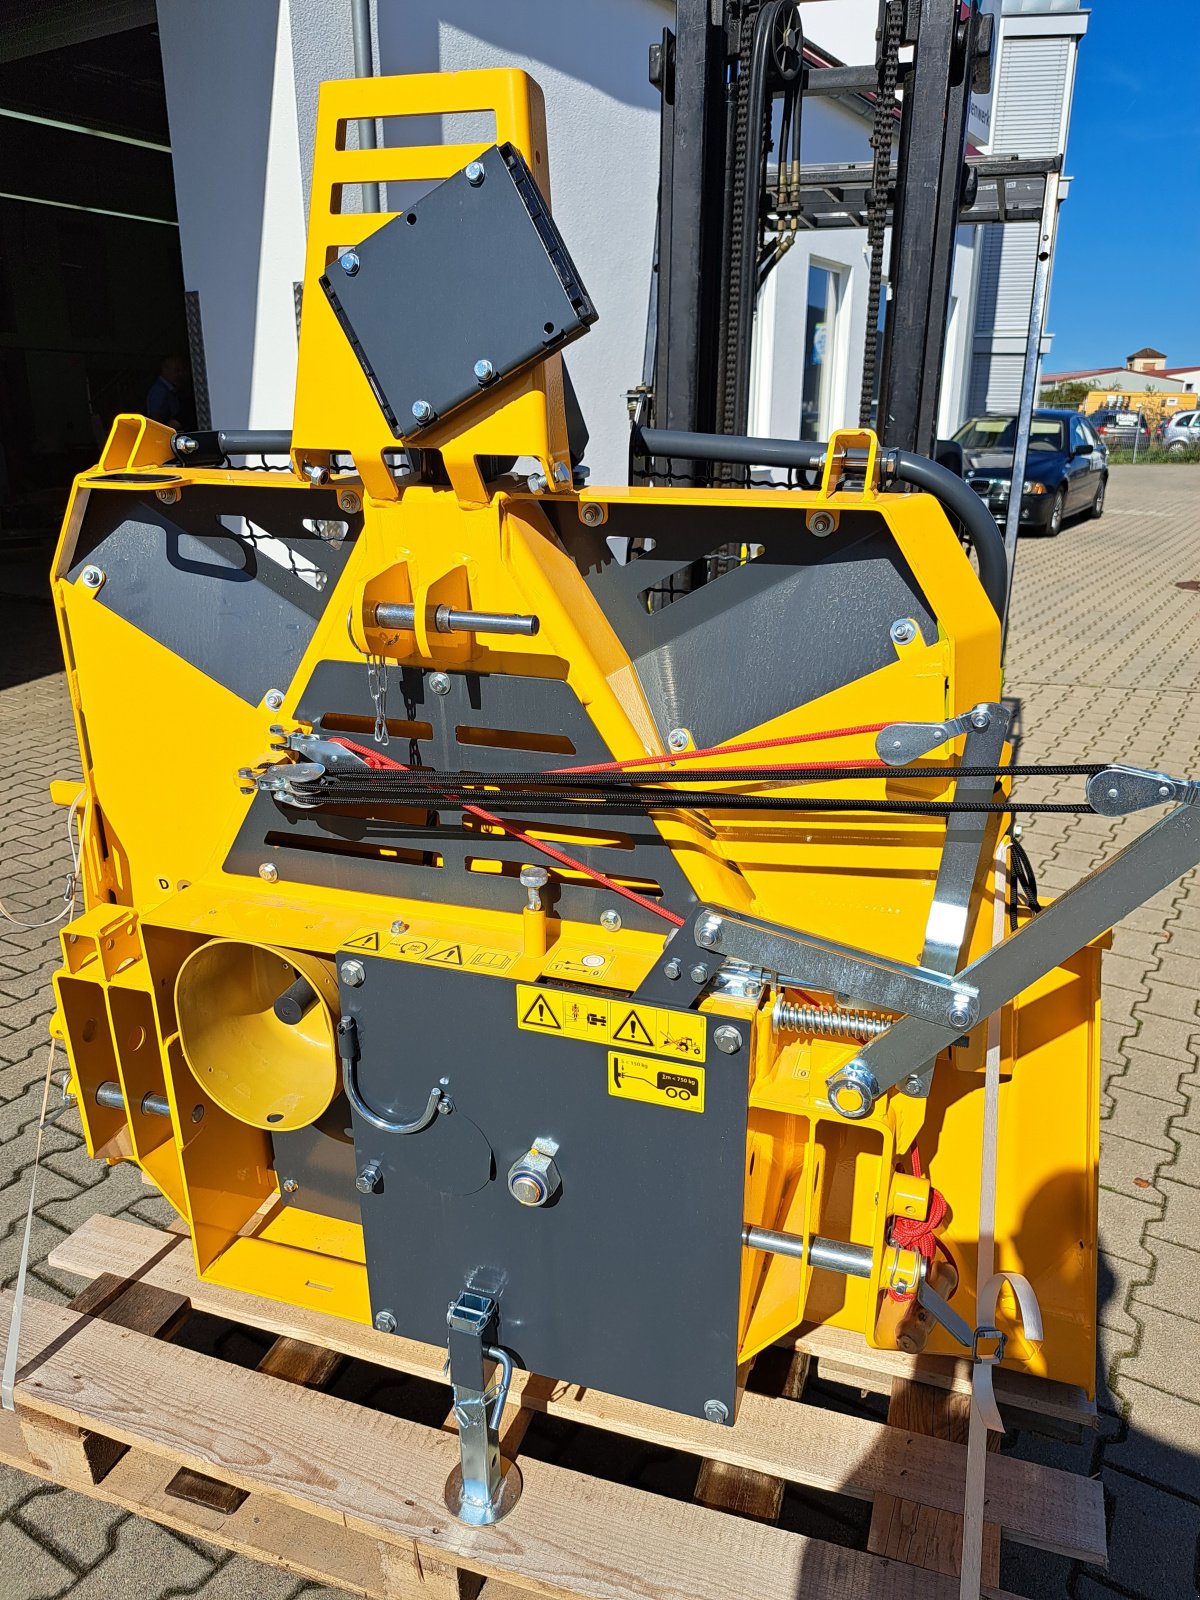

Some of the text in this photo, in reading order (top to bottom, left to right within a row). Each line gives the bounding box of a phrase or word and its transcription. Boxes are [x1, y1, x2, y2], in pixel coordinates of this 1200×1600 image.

[970, 103, 990, 127] enwerk
[158, 878, 169, 890] D
[677, 1076, 688, 1084] 750
